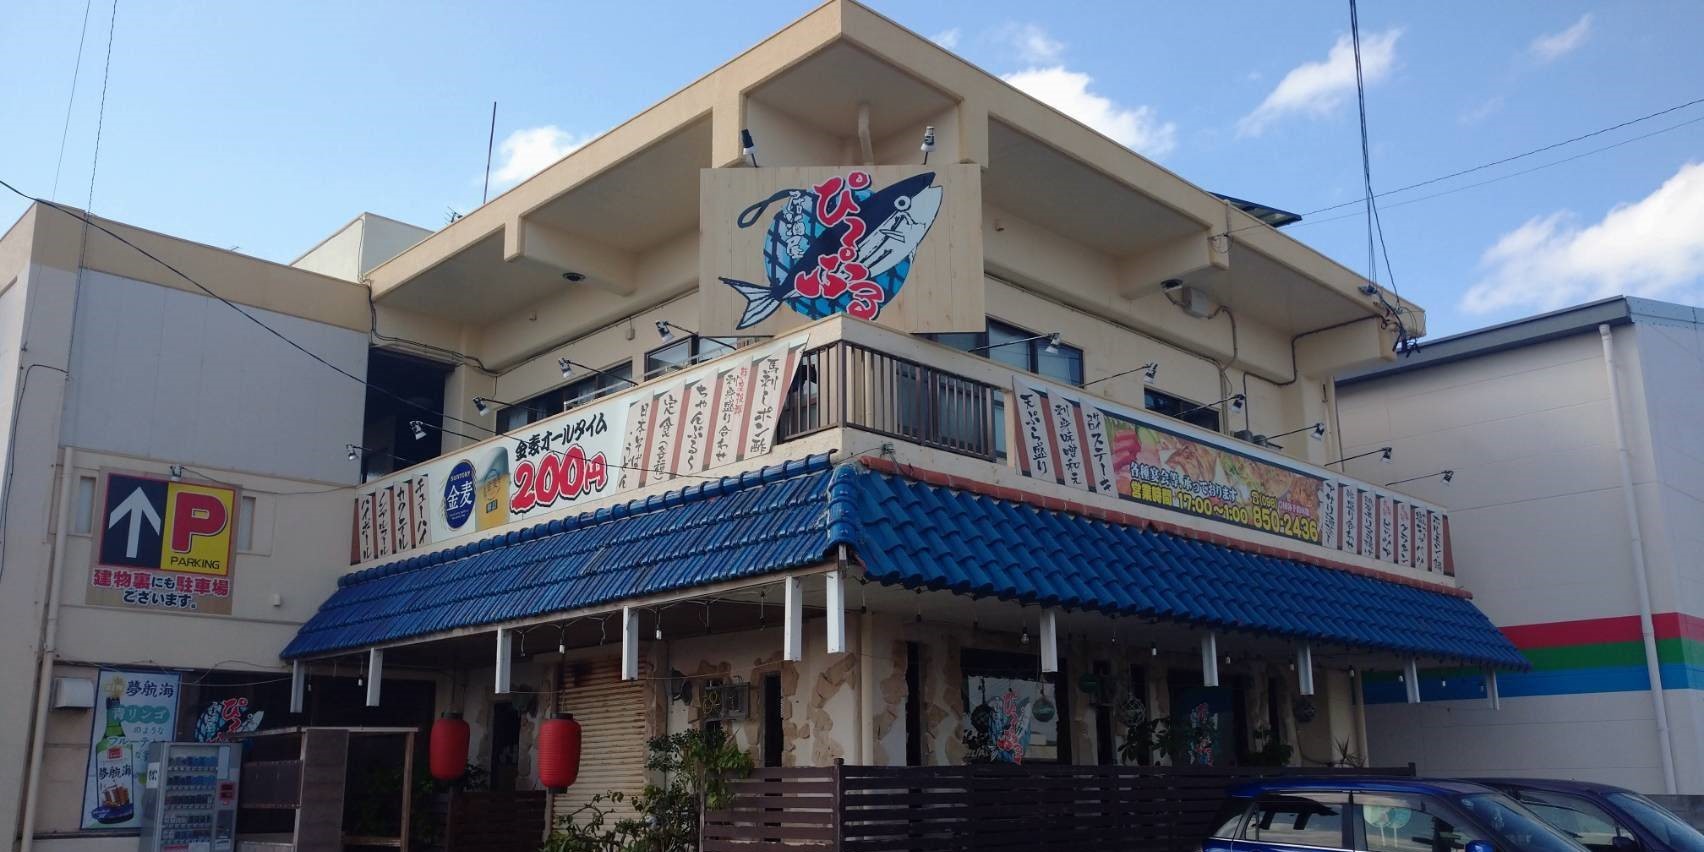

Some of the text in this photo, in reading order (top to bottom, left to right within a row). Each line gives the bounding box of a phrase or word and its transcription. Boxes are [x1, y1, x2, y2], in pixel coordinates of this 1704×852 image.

[515, 412, 608, 462] 金麦オールタイム
[716, 374, 738, 461] 刺身盛り合わせ
[1020, 394, 1047, 474] 天ぷら盛り
[447, 481, 473, 512] 金麦
[511, 444, 609, 516] 200円
[1130, 480, 1173, 505] 営業時間
[171, 492, 228, 554] P
[397, 487, 408, 550] カクテル
[415, 478, 427, 544] チューハイ
[93, 569, 230, 596] 建物裏にも駐車場
[170, 556, 220, 570] PARKING
[123, 589, 197, 609] ございます。
[126, 679, 175, 698] 夢航海
